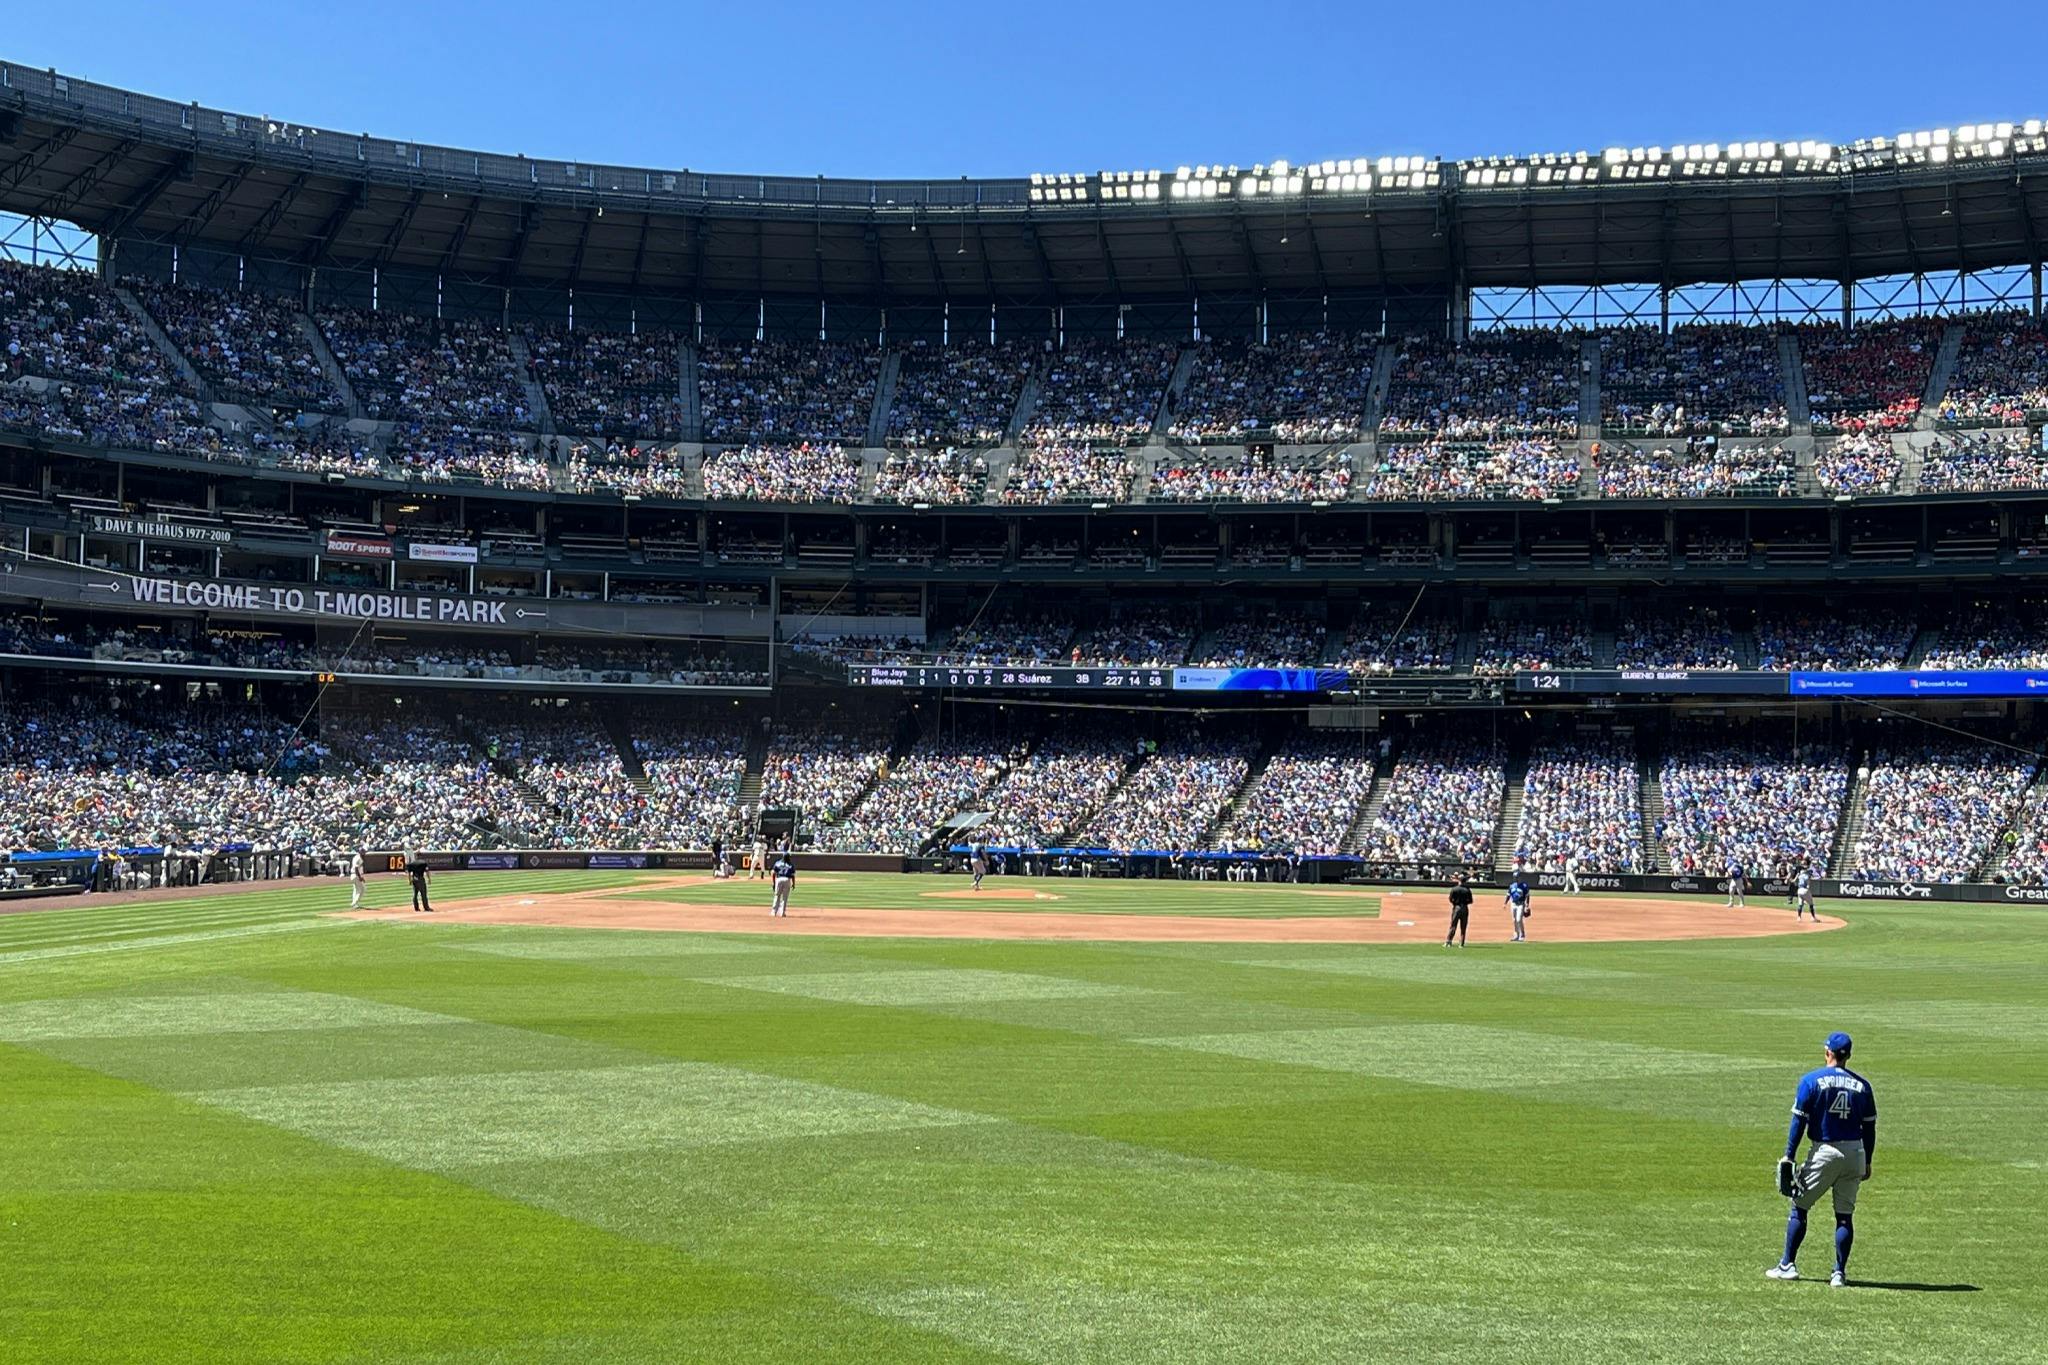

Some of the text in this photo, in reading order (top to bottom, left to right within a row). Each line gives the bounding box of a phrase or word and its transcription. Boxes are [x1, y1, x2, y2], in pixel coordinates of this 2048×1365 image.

[105, 518, 231, 542] DAVE NIEHAUS 1977-2010
[327, 540, 392, 554] ROOT SPORTS
[131, 576, 506, 624] WELCOME TO T-MOBILE PARK
[871, 668, 908, 678] Blue Jays
[919, 668, 926, 677] 0
[871, 677, 904, 686] Mariners
[919, 677, 926, 686] 0
[950, 674, 958, 685] 0
[967, 674, 975, 685] 0
[984, 675, 992, 685] 2
[1002, 673, 1090, 684] 28 Suárez 3B
[1102, 676, 1124, 686] .227
[1129, 676, 1141, 686] 14
[1149, 676, 1162, 686] 58
[1532, 675, 1561, 688] 1:24
[1577, 877, 1621, 888] SPORTS
[1839, 883, 1899, 898] KeyBank
[2005, 886, 2048, 900] Great
[1817, 1076, 1864, 1093] SPRINGER
[1828, 1090, 1851, 1119] 4
